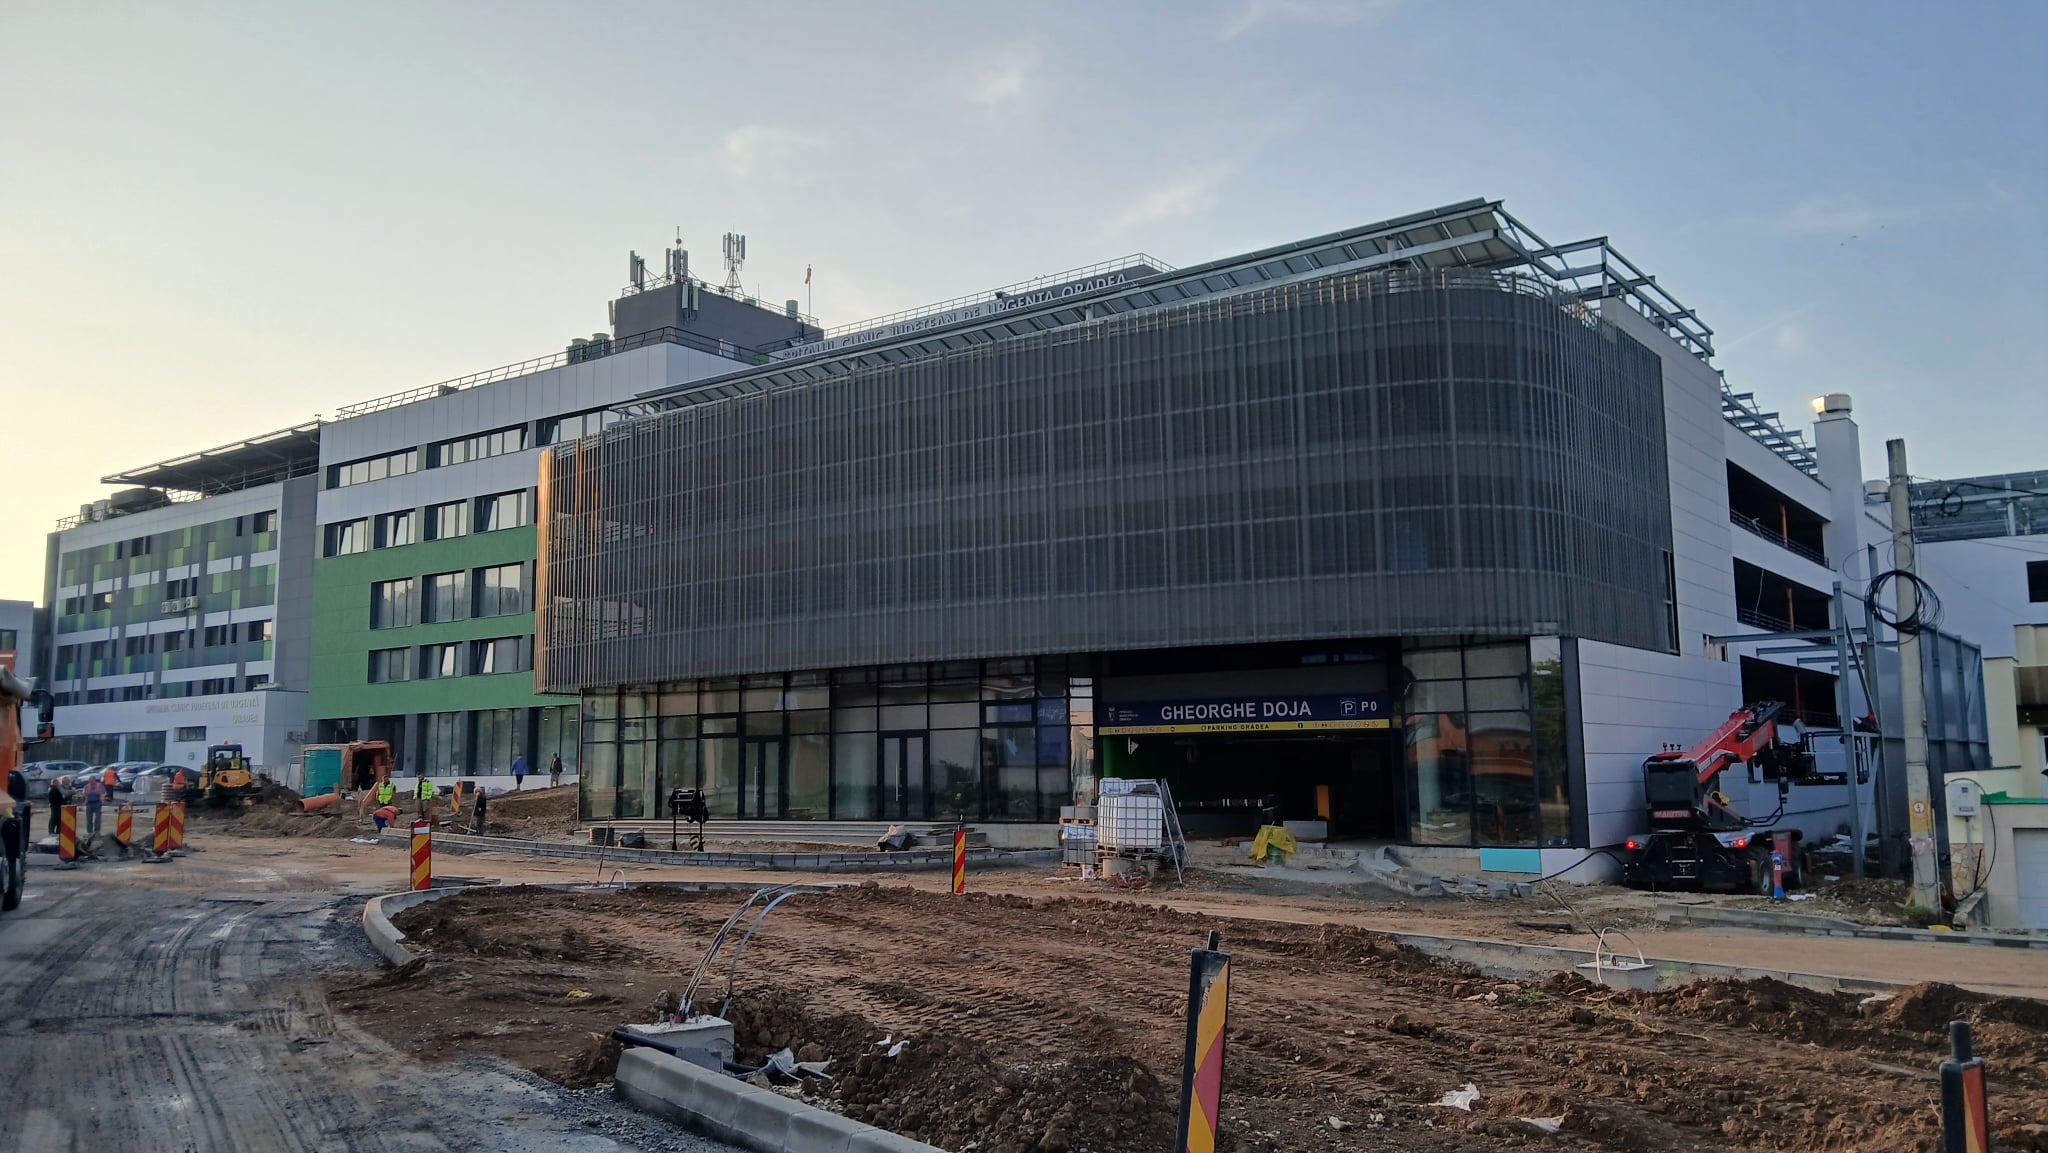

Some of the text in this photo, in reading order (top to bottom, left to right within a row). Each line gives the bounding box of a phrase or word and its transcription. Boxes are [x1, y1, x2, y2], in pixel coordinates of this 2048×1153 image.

[1061, 273, 1126, 297] ORADEA
[1161, 701, 1312, 720] GHEORGHE DOJA
